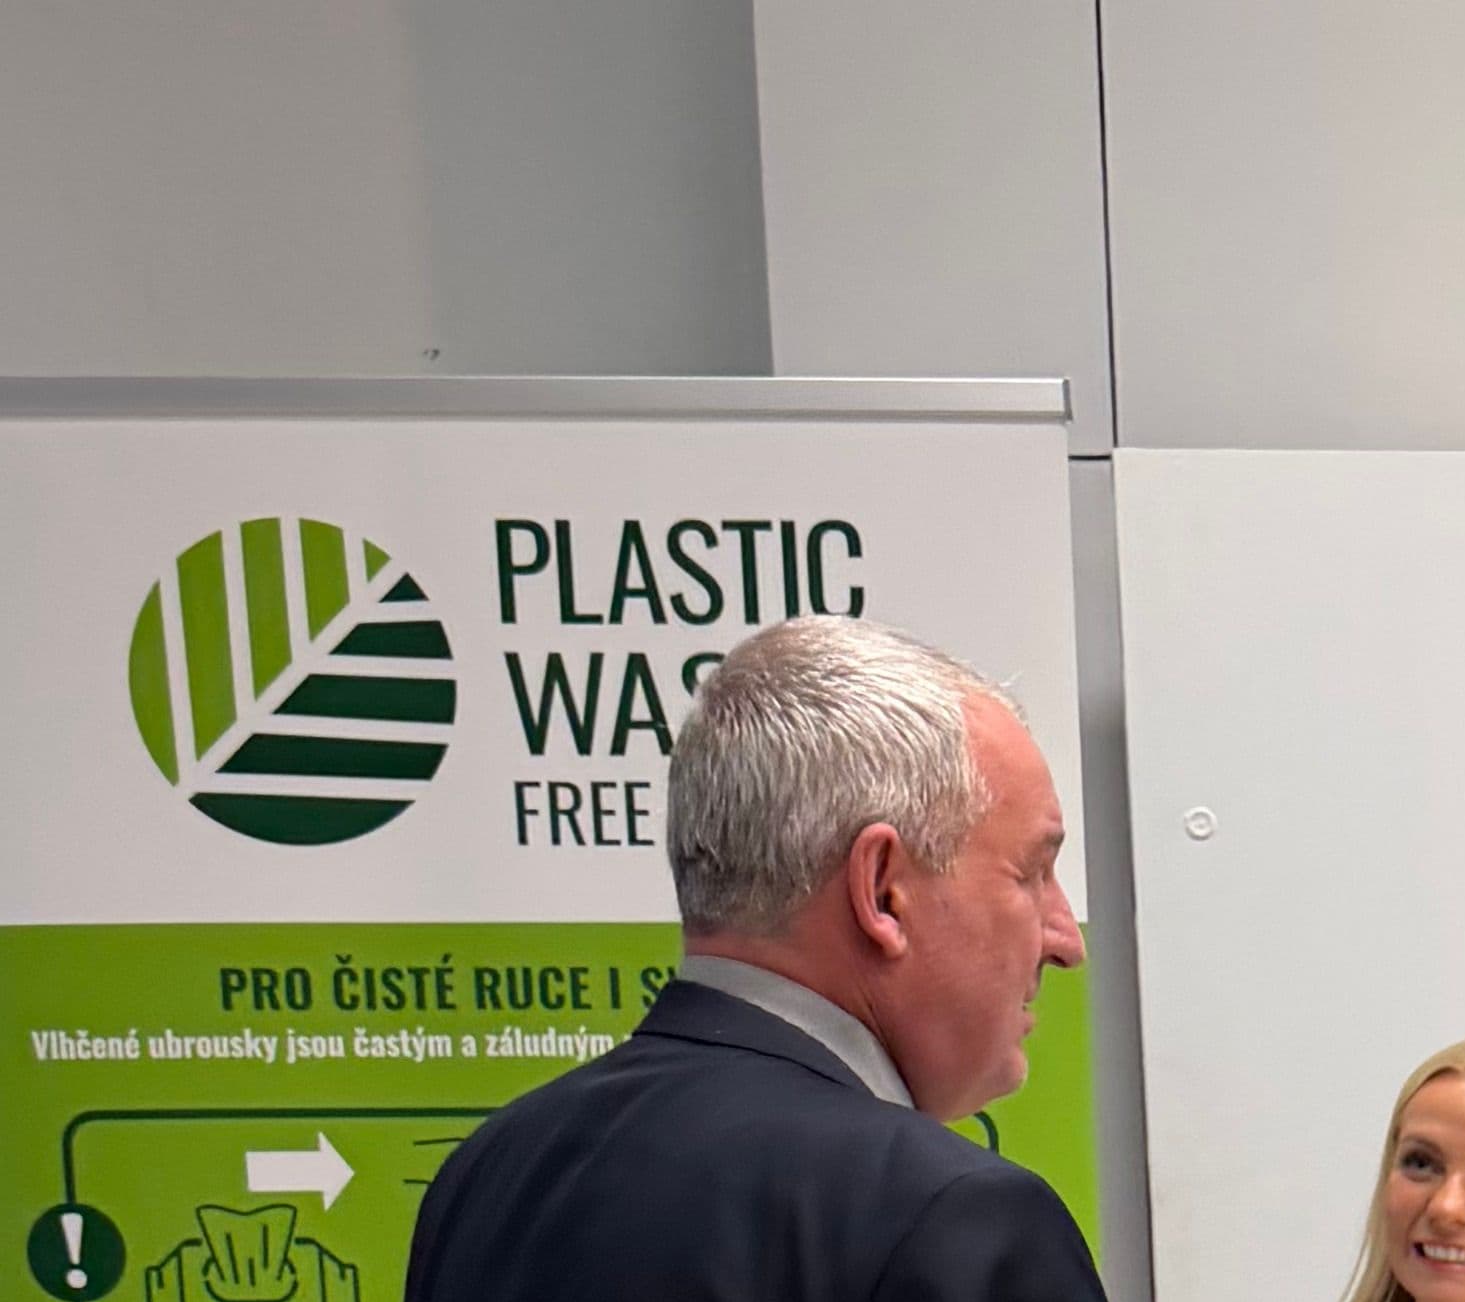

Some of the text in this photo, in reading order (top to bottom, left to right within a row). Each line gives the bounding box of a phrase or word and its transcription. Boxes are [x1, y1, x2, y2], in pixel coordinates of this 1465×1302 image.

[494, 519, 865, 625] PLASTIC
[514, 780, 656, 847] FREE
[219, 967, 313, 1011] PRO
[332, 953, 457, 1011] ČISTÉ
[473, 966, 592, 1010] RUCE
[609, 966, 622, 1010] I
[30, 1026, 616, 1064] Vlhčené ubrousky jsou častým a záludným
